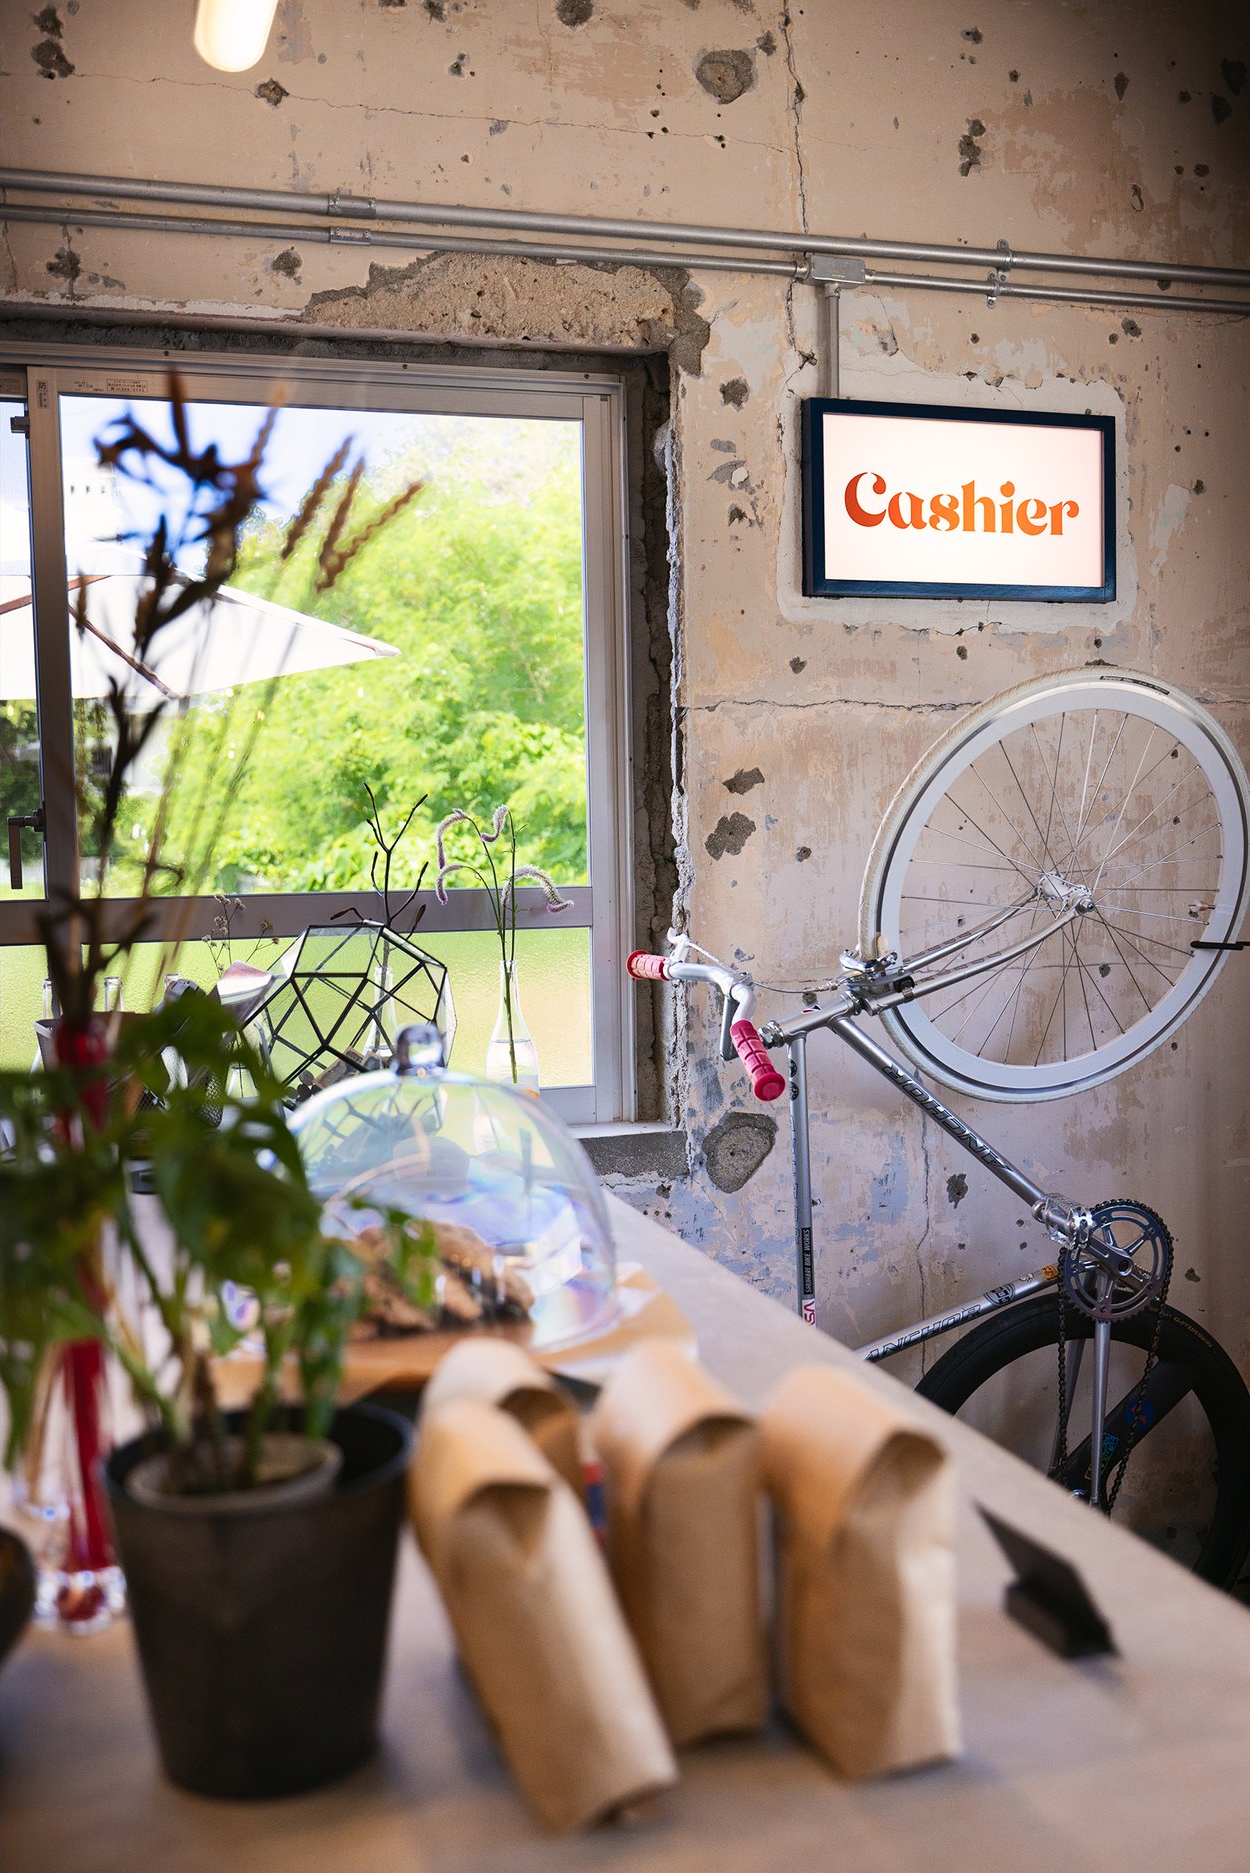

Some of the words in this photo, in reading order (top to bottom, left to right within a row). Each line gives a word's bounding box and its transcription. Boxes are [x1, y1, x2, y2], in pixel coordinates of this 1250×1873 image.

[844, 471, 1079, 535] Cashier
[882, 1064, 1013, 1171] ANCHOR
[803, 1229, 811, 1251] WORKS
[865, 1304, 982, 1363] ANCHOR
